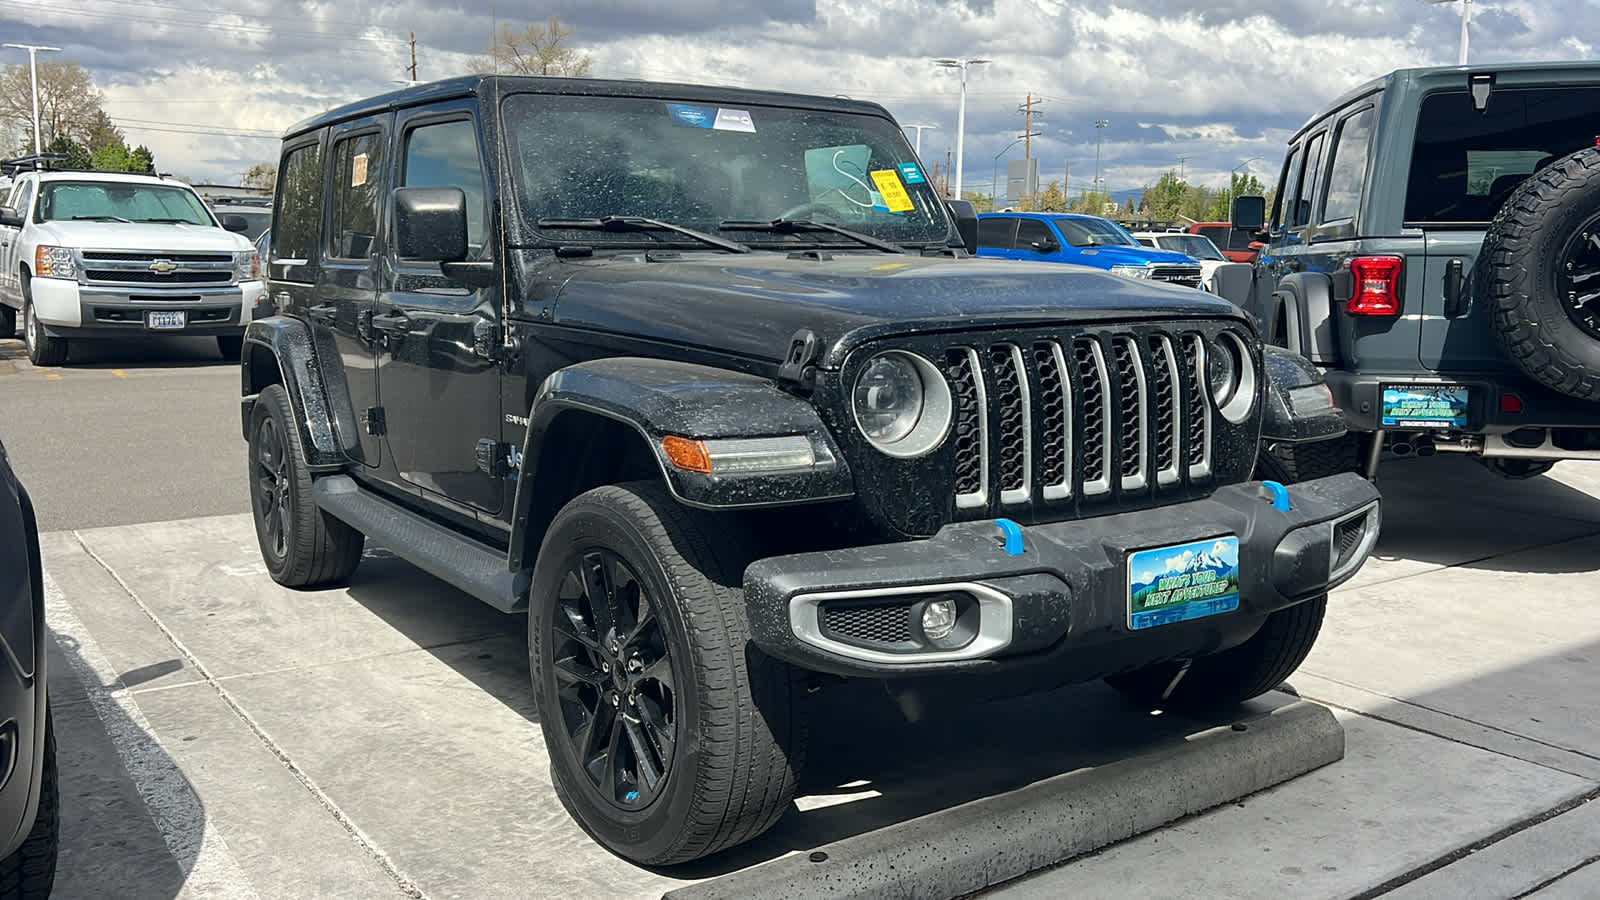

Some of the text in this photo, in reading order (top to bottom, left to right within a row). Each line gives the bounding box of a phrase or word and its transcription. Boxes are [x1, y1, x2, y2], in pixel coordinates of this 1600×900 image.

[1158, 569, 1217, 591] WHAT'S YOUR
[1144, 580, 1229, 608] NEXT ADVENTURE?
